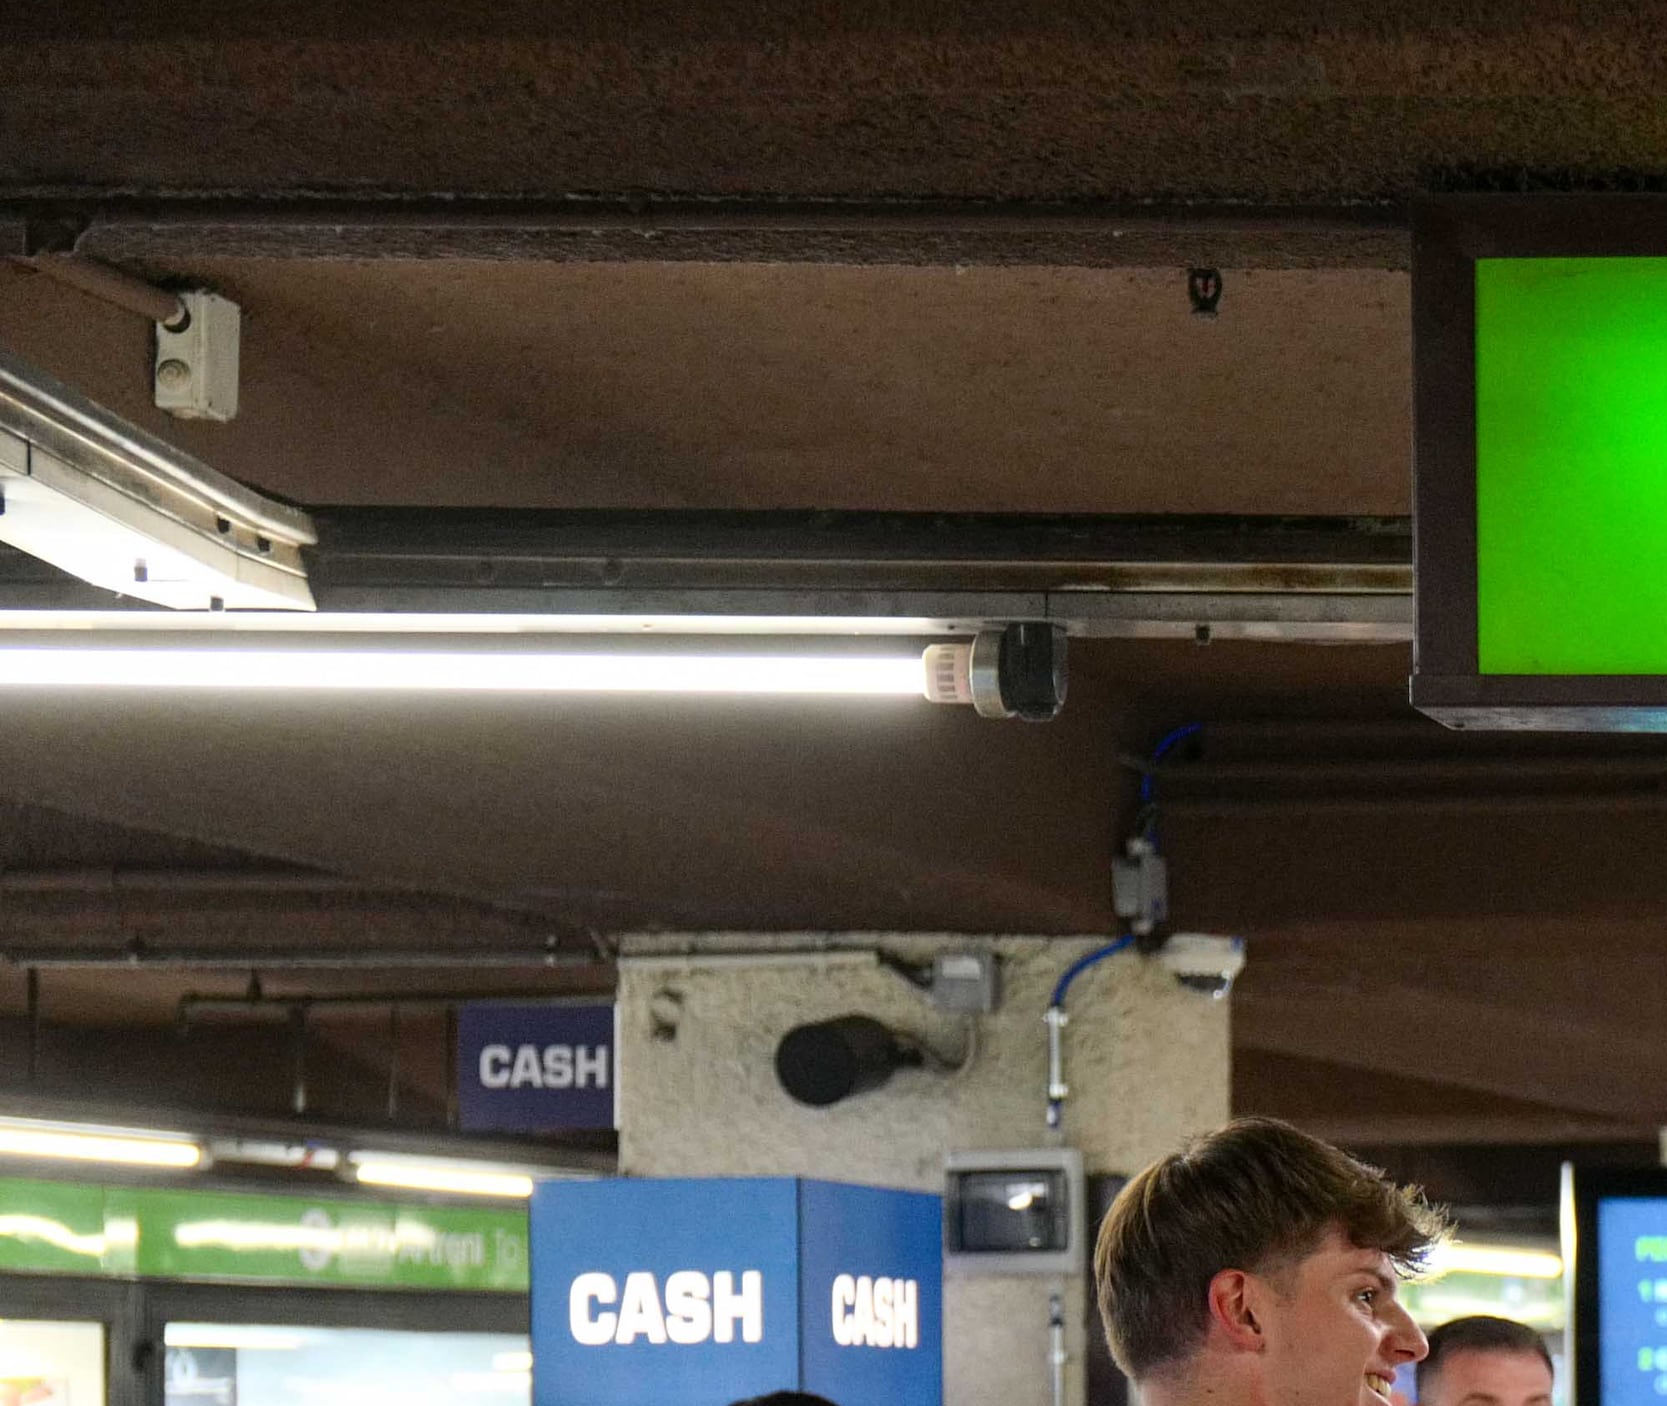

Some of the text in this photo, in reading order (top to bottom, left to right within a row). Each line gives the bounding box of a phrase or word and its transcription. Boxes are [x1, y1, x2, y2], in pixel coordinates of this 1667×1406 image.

[479, 1044, 608, 1088] CASH
[569, 1270, 763, 1345] CASH
[831, 1273, 918, 1349] CASH
